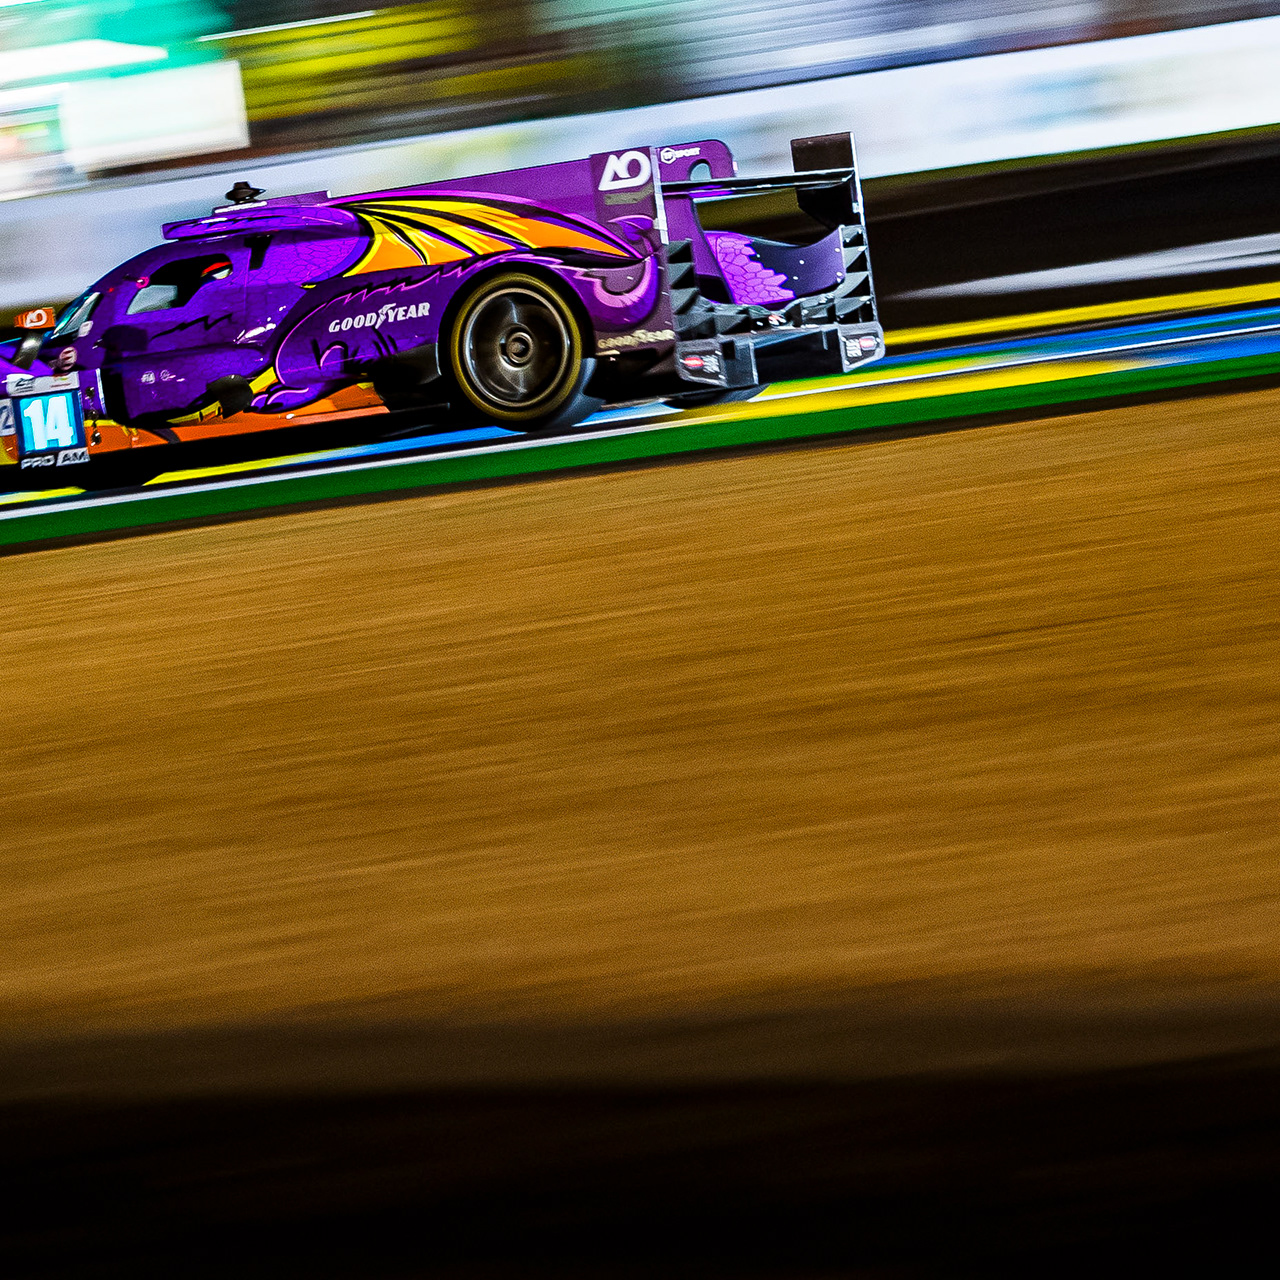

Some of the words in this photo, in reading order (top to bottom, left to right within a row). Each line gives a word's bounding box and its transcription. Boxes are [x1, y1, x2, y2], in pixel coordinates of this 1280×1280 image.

[598, 151, 651, 191] AO
[328, 302, 430, 333] GOODYEAR
[24, 395, 74, 450] 14
[21, 455, 55, 469] PRO
[61, 449, 89, 464] AM
